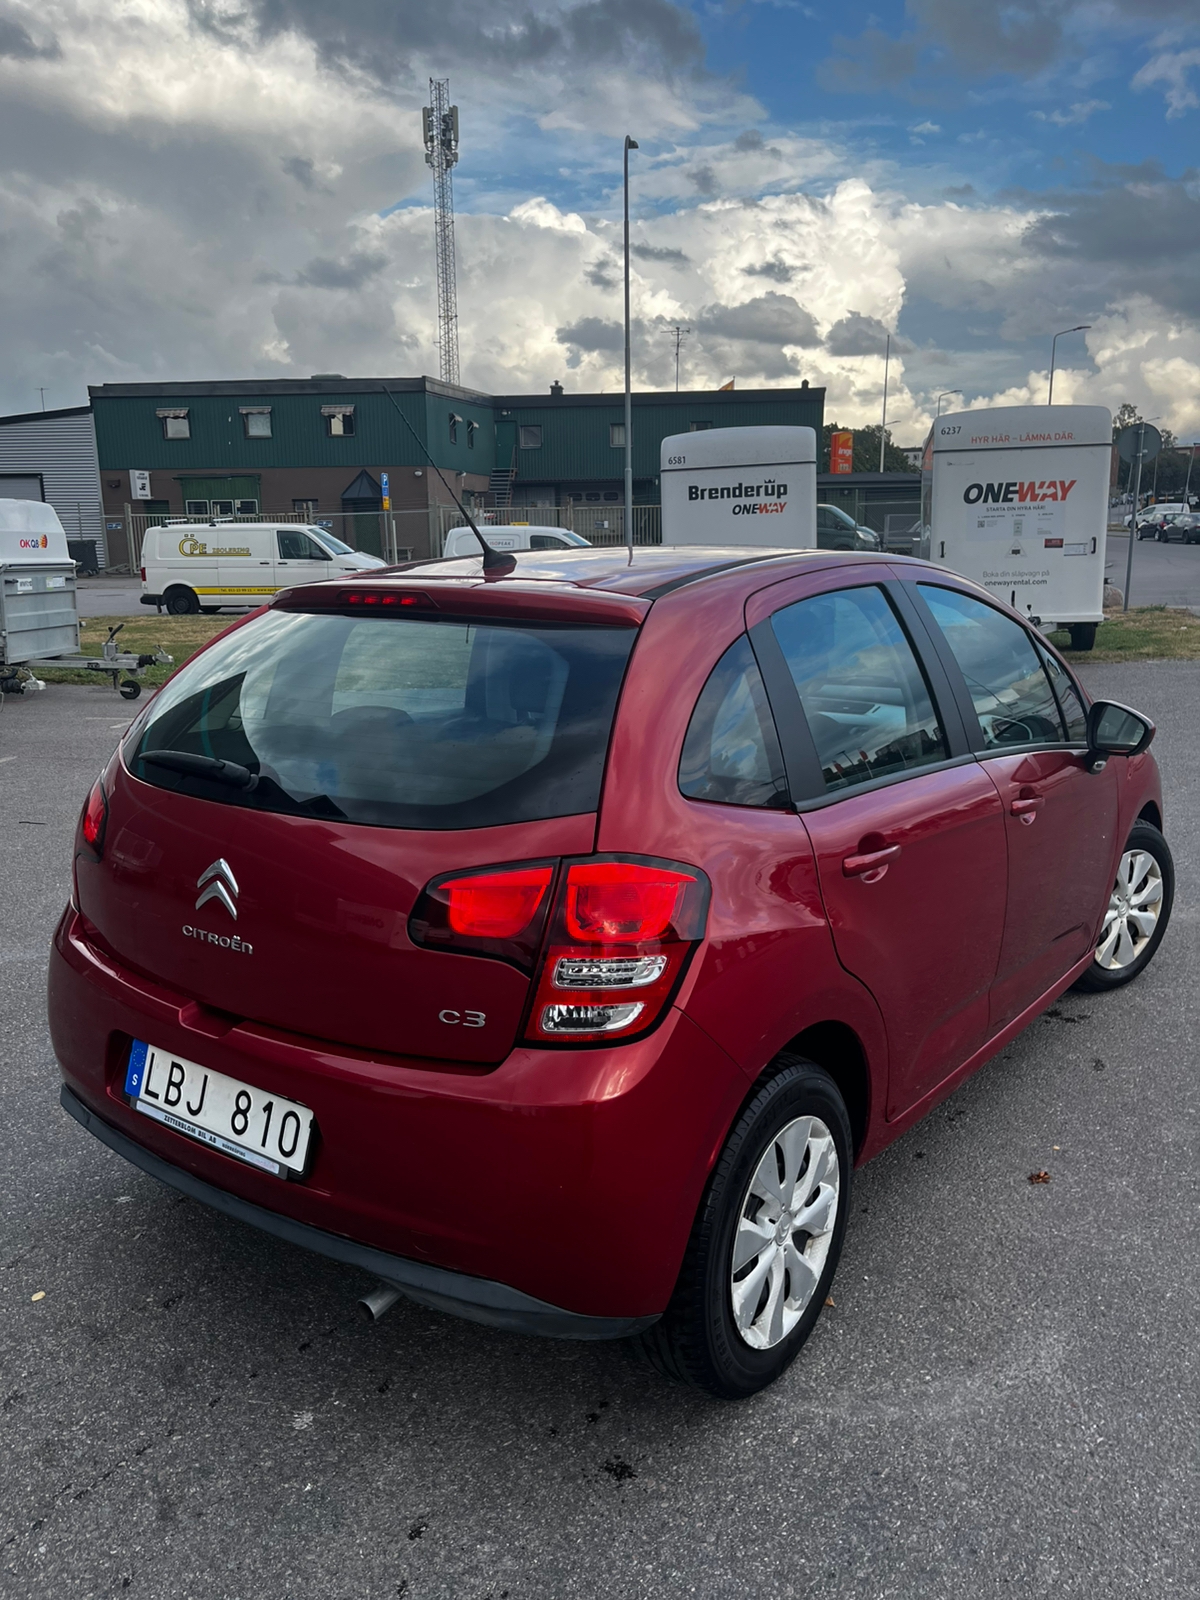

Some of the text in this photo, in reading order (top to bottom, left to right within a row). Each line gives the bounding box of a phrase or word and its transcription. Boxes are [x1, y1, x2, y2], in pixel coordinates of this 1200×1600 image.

[940, 426, 962, 436] 6237
[971, 436, 989, 444] HYR
[991, 433, 1010, 443] HÄR
[1019, 432, 1052, 442] LÄMNA
[1054, 431, 1076, 441] DÄR.
[668, 456, 686, 465] 6581
[688, 480, 788, 501] Brenderup
[963, 480, 1077, 505] ONEWAY
[732, 502, 787, 516] ONEWAY
[1011, 570, 1040, 579] släpvagn
[1041, 570, 1050, 578] på
[984, 579, 1048, 587] onewayrental.com
[438, 1009, 486, 1028] C3
[131, 1073, 139, 1086] S
[144, 1052, 301, 1158] LBJ 810
[163, 1114, 197, 1135] ZETTERBLOM
[197, 1130, 207, 1140] BIL
[208, 1135, 217, 1144] AB
